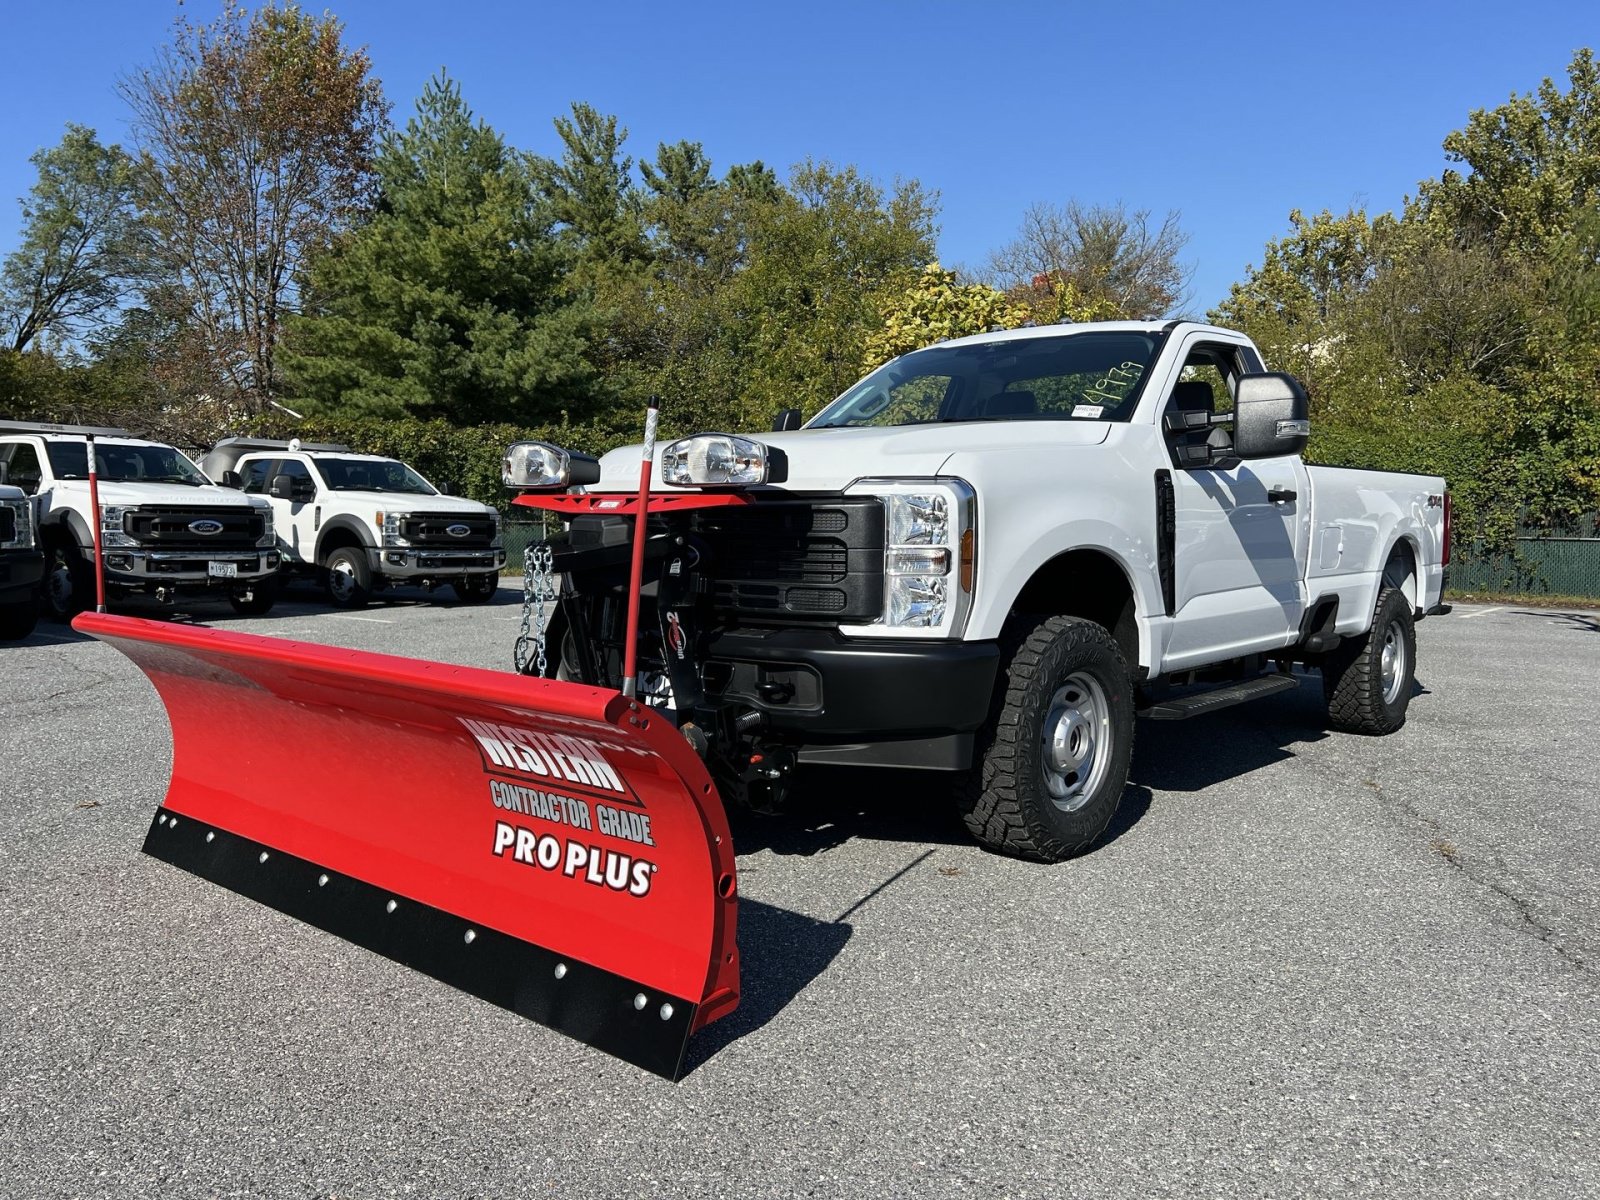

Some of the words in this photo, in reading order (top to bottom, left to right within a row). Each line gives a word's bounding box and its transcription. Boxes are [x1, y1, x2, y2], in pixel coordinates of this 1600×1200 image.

[456, 716, 625, 793] WESTERN
[489, 779, 593, 831] CONTRACTOR
[596, 803, 655, 846] GRADE
[492, 820, 561, 871] PRO
